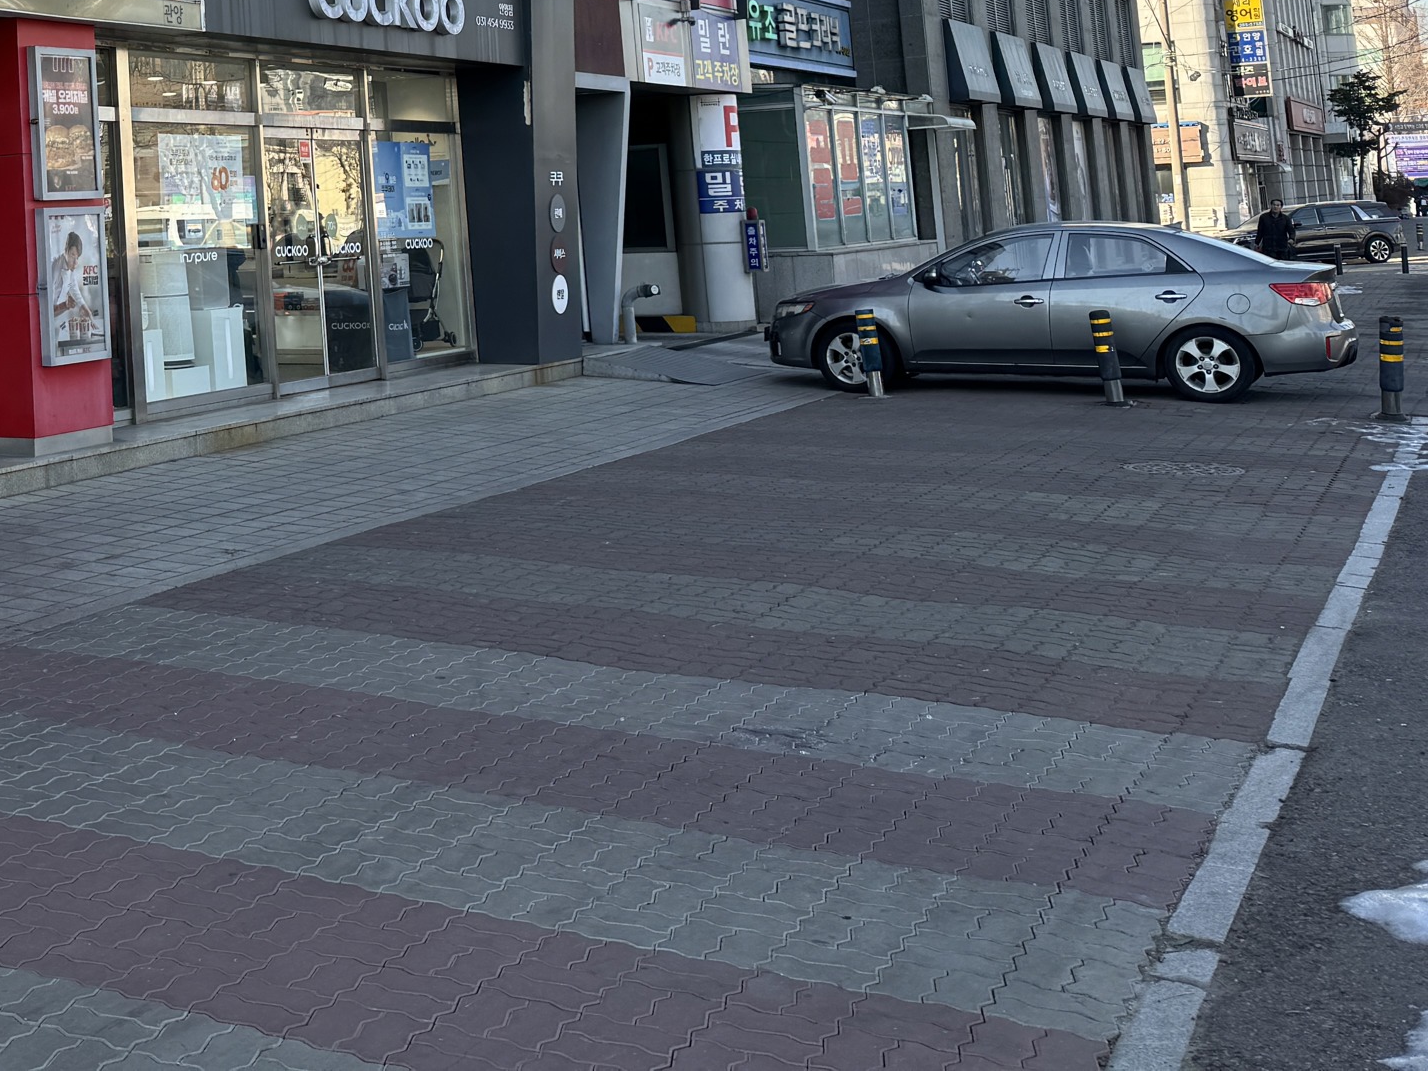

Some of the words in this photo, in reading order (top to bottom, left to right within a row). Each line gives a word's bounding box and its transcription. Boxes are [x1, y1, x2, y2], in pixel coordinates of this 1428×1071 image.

[164, 4, 183, 25] 관양
[475, 15, 486, 27] 031
[698, 19, 730, 55] 밀란
[695, 59, 713, 82] 고객
[714, 61, 739, 85] 주차장
[723, 105, 740, 148] P
[549, 171, 564, 186] 쿠쿠
[275, 244, 309, 257] CUCKOO
[405, 237, 433, 249] CUCKOO
[83, 265, 98, 275] KFC
